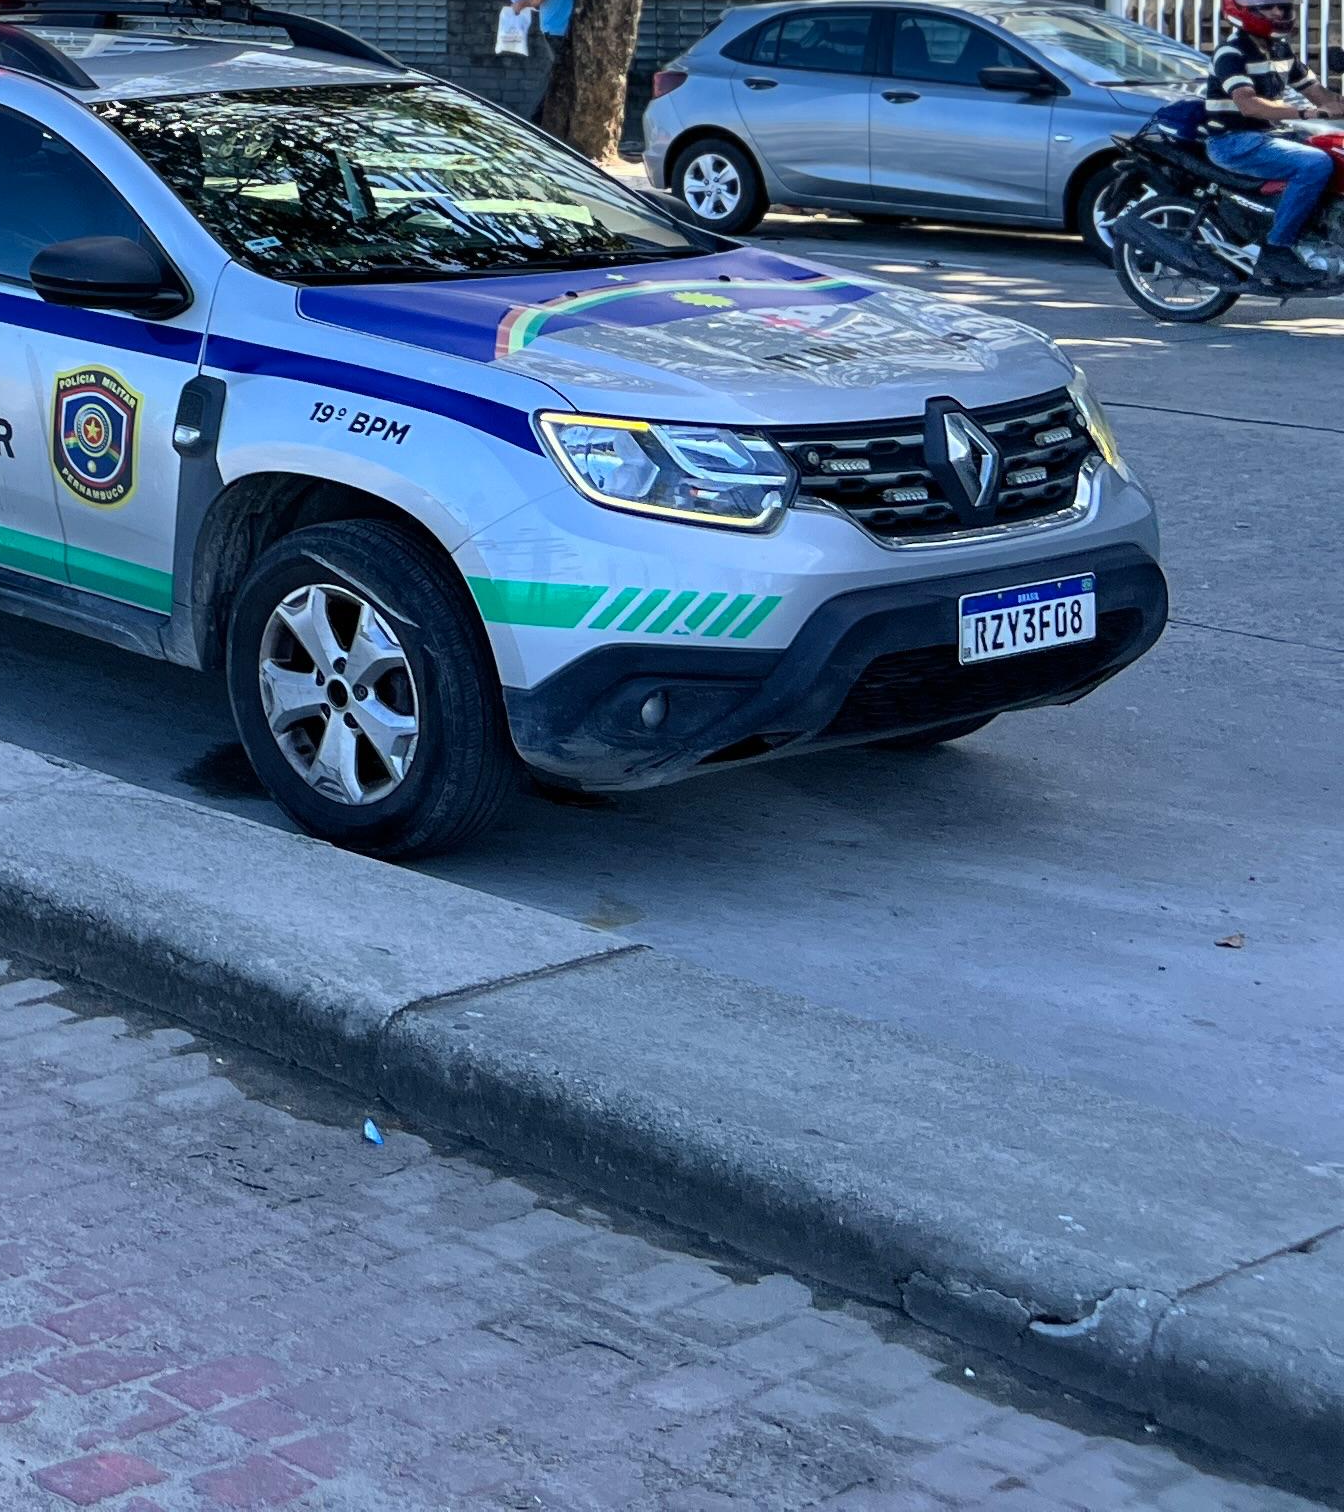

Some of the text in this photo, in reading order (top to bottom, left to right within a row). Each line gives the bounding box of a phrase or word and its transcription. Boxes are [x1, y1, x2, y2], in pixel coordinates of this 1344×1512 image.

[59, 374, 136, 409] POLÍCIA MILITAR
[310, 402, 411, 445] 19º BPM
[62, 466, 124, 500] PERNAMBUCO
[1017, 591, 1040, 603] BRASIL
[974, 599, 1083, 654] RZY3F08
